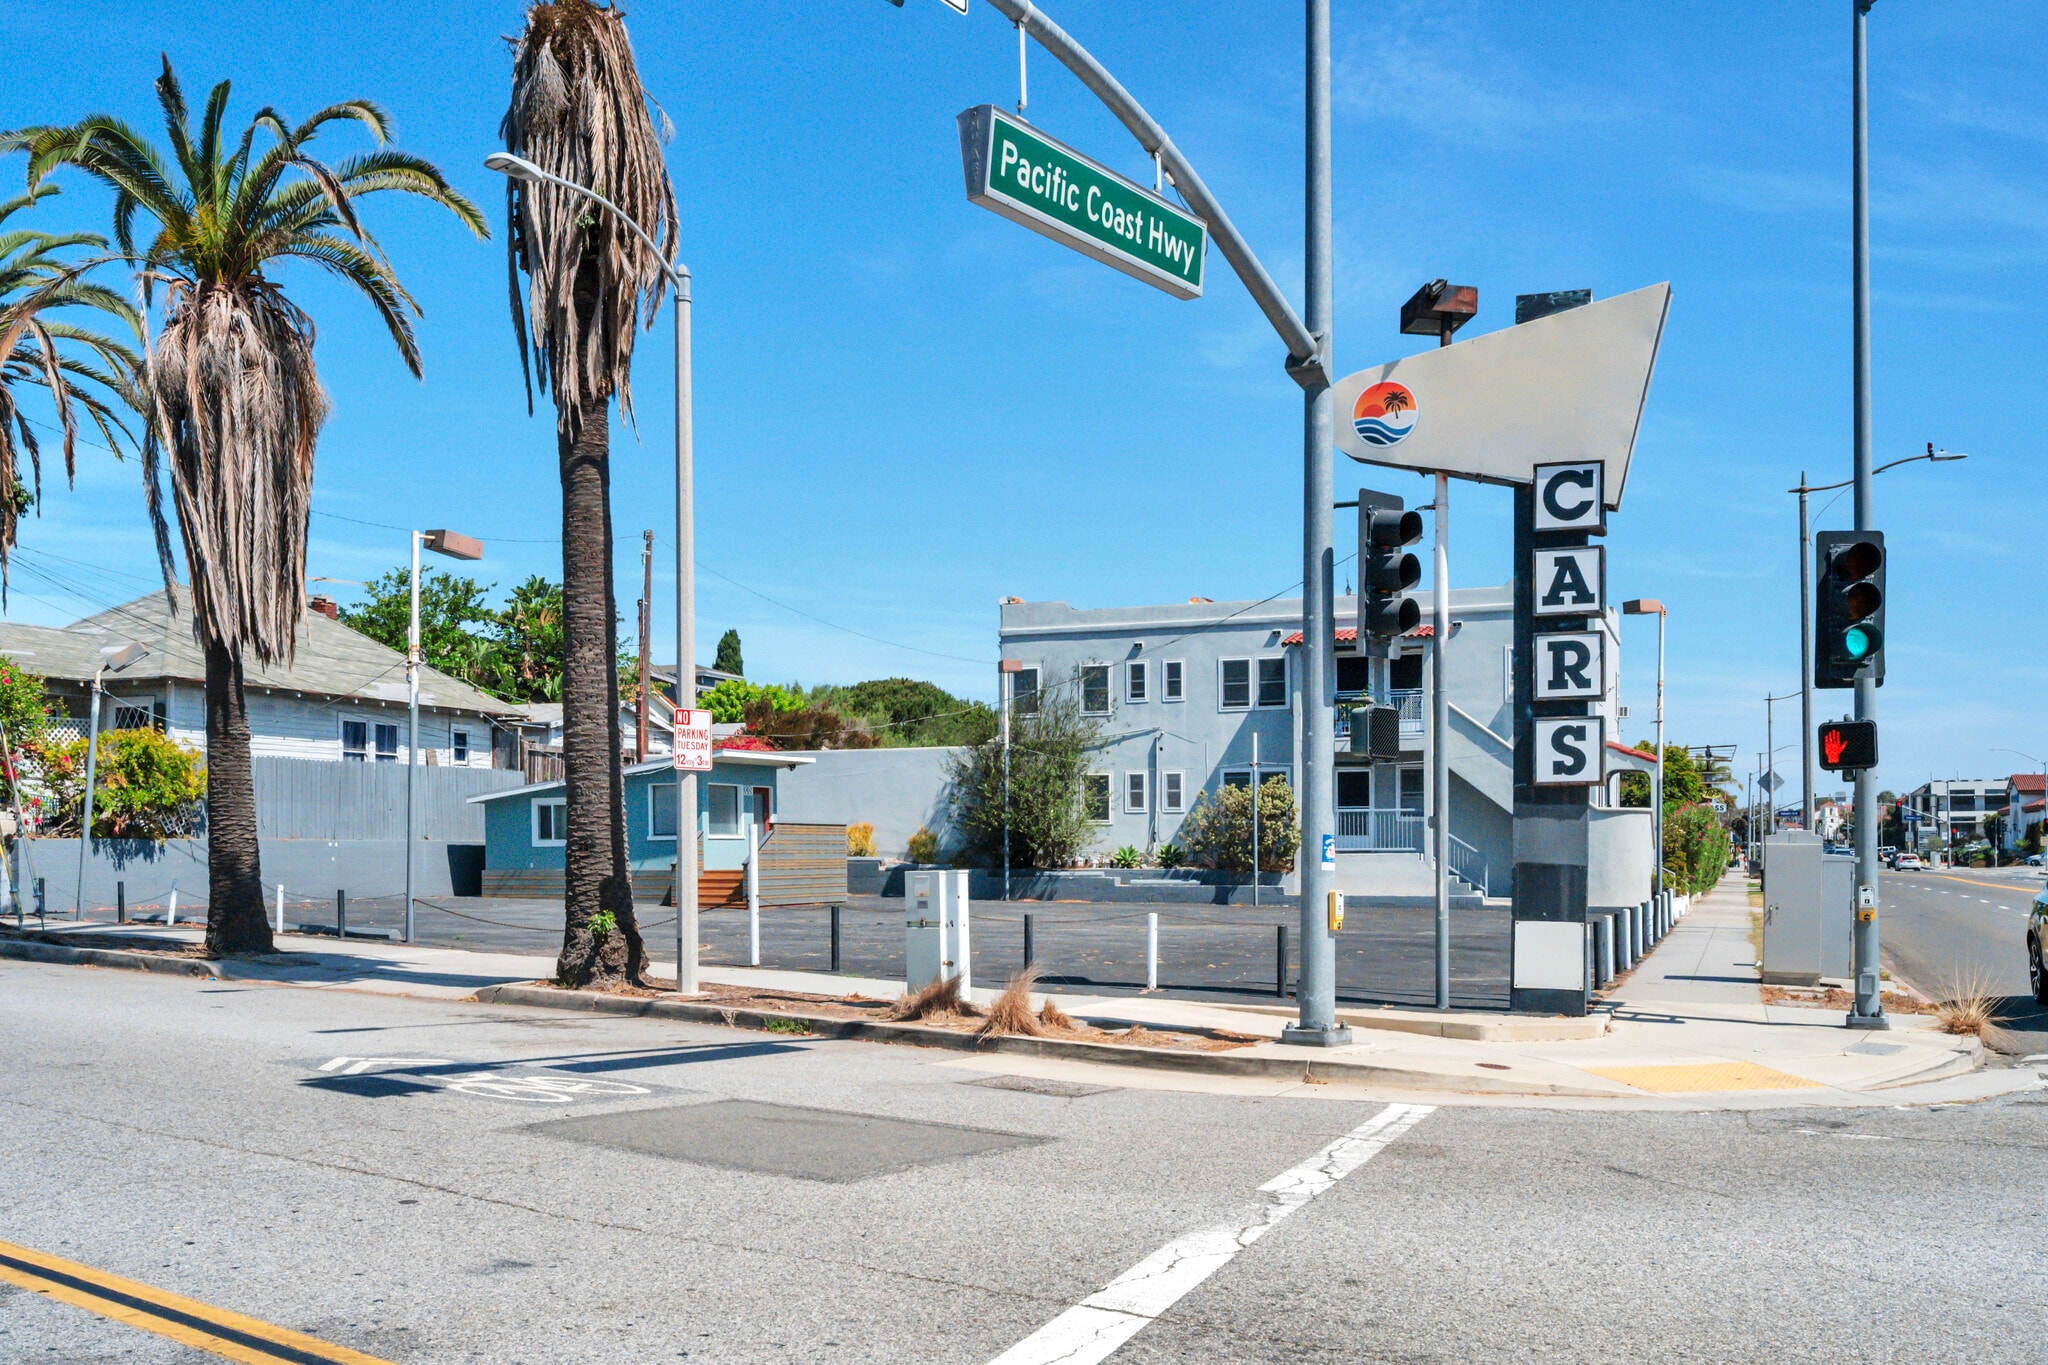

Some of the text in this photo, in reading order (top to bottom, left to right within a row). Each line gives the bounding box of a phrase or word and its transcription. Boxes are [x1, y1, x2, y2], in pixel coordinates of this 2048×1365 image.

[1000, 138, 1196, 276] Pacific Coast Hwy
[1541, 468, 1596, 777] CARS
[677, 710, 689, 724] NO
[677, 727, 709, 741] PARKING
[677, 740, 709, 750] TUESDAY
